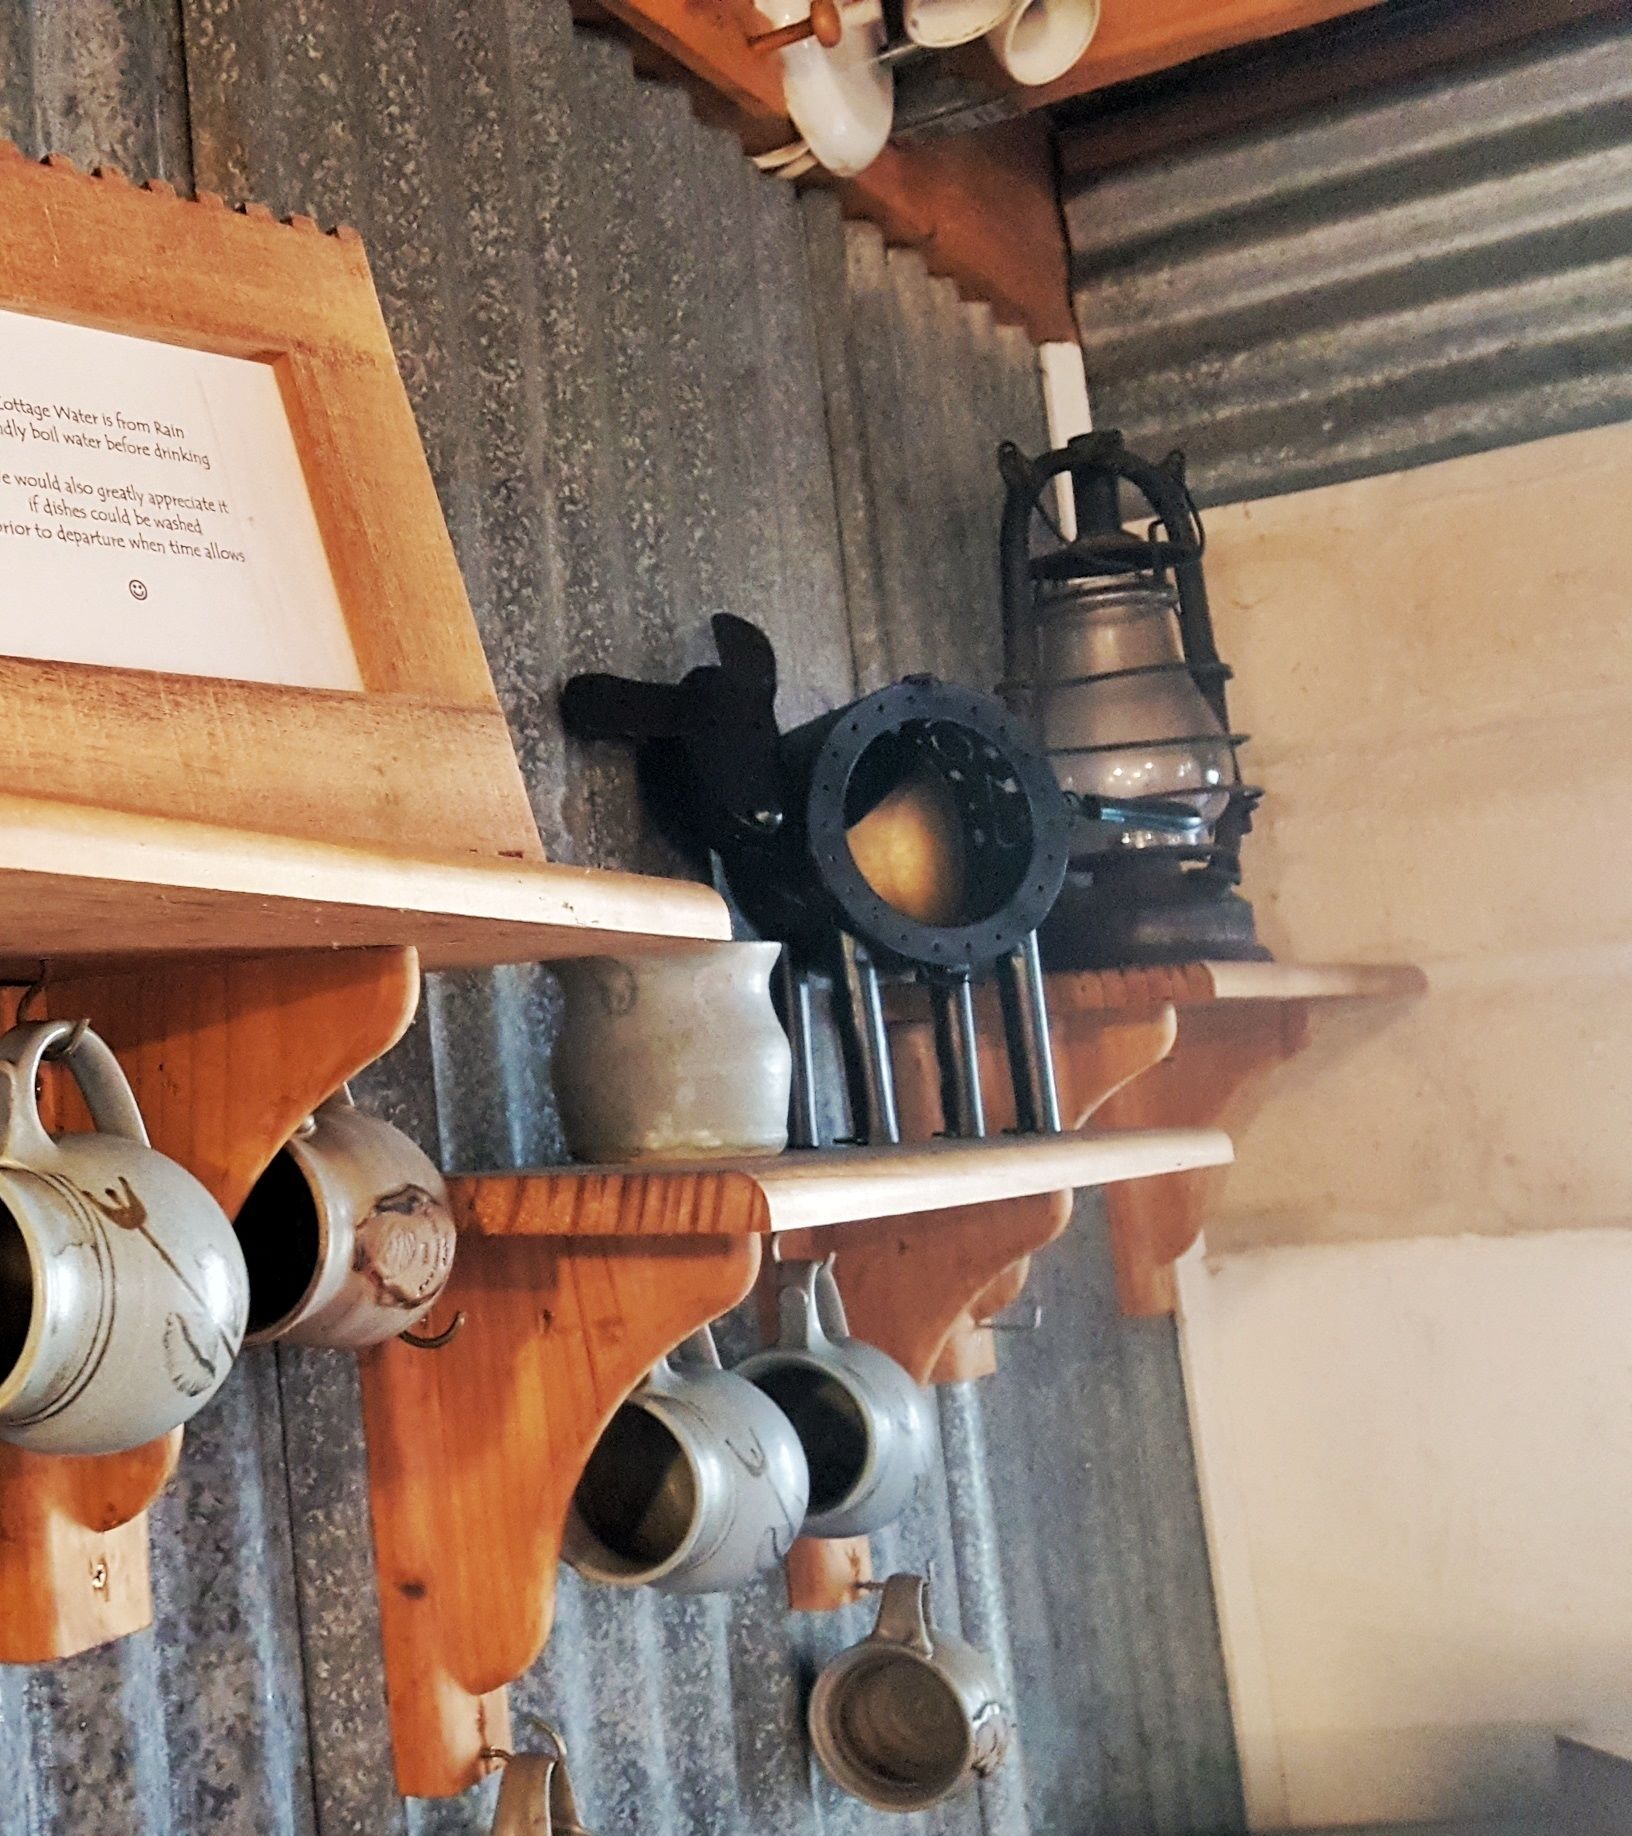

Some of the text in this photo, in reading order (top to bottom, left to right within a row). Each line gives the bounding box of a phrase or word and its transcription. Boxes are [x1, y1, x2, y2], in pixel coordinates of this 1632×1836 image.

[53, 405, 98, 425] Water
[101, 412, 113, 428] is
[116, 411, 151, 434] from
[154, 421, 185, 439] Rain
[30, 422, 58, 444] boil
[63, 431, 101, 450] water
[106, 435, 151, 457] before
[154, 442, 211, 470] drinking
[14, 471, 60, 493] would
[64, 476, 93, 496] also
[97, 484, 144, 506] greatly
[148, 490, 215, 513] appreciate
[217, 500, 229, 514] it
[28, 496, 202, 535] if dishes could be washed
[35, 524, 52, 539] to
[57, 524, 126, 548] departure
[129, 536, 166, 554] when
[169, 541, 202, 558] time
[205, 542, 246, 563] allows
